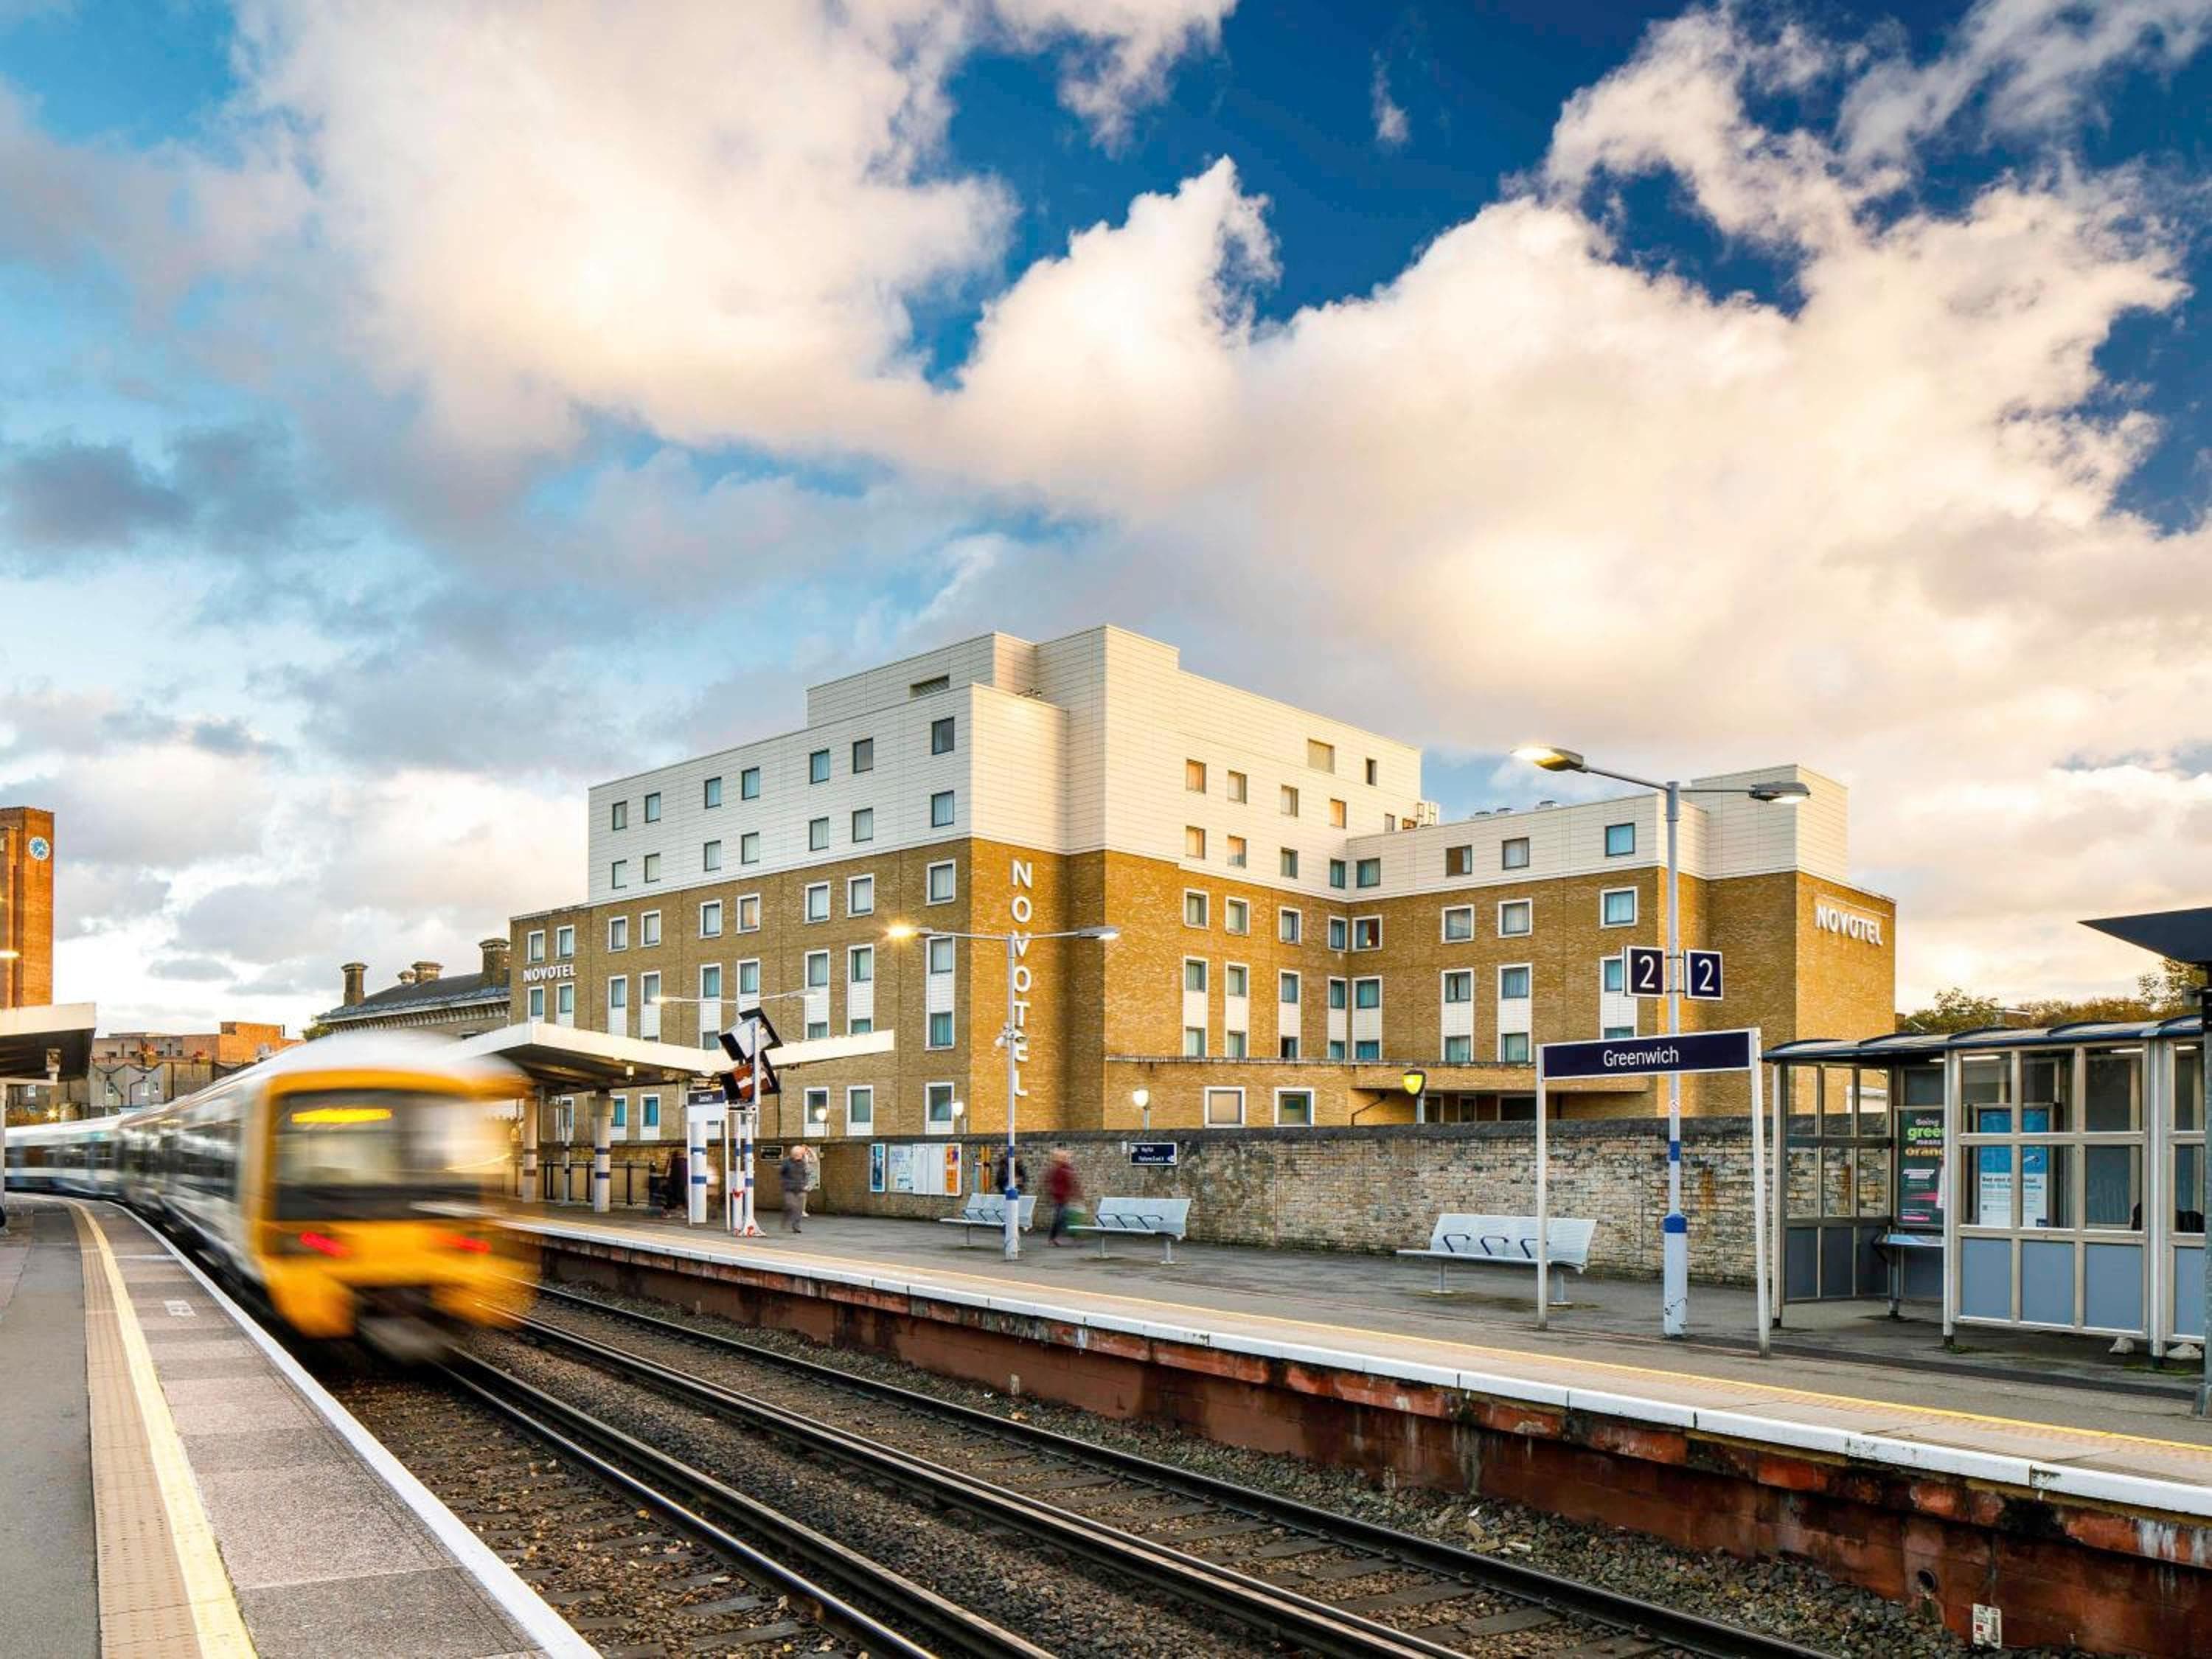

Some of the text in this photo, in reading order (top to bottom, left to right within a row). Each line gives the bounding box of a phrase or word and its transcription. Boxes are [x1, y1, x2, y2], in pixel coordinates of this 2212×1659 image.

[1816, 904, 1884, 946] NOVOTEL
[523, 964, 577, 982] NOVOTEL
[1011, 860, 1032, 1096] NOVOTEL
[1639, 955, 1655, 989] 2
[1698, 959, 1714, 992] 2
[1603, 1046, 1679, 1067] Greenwich
